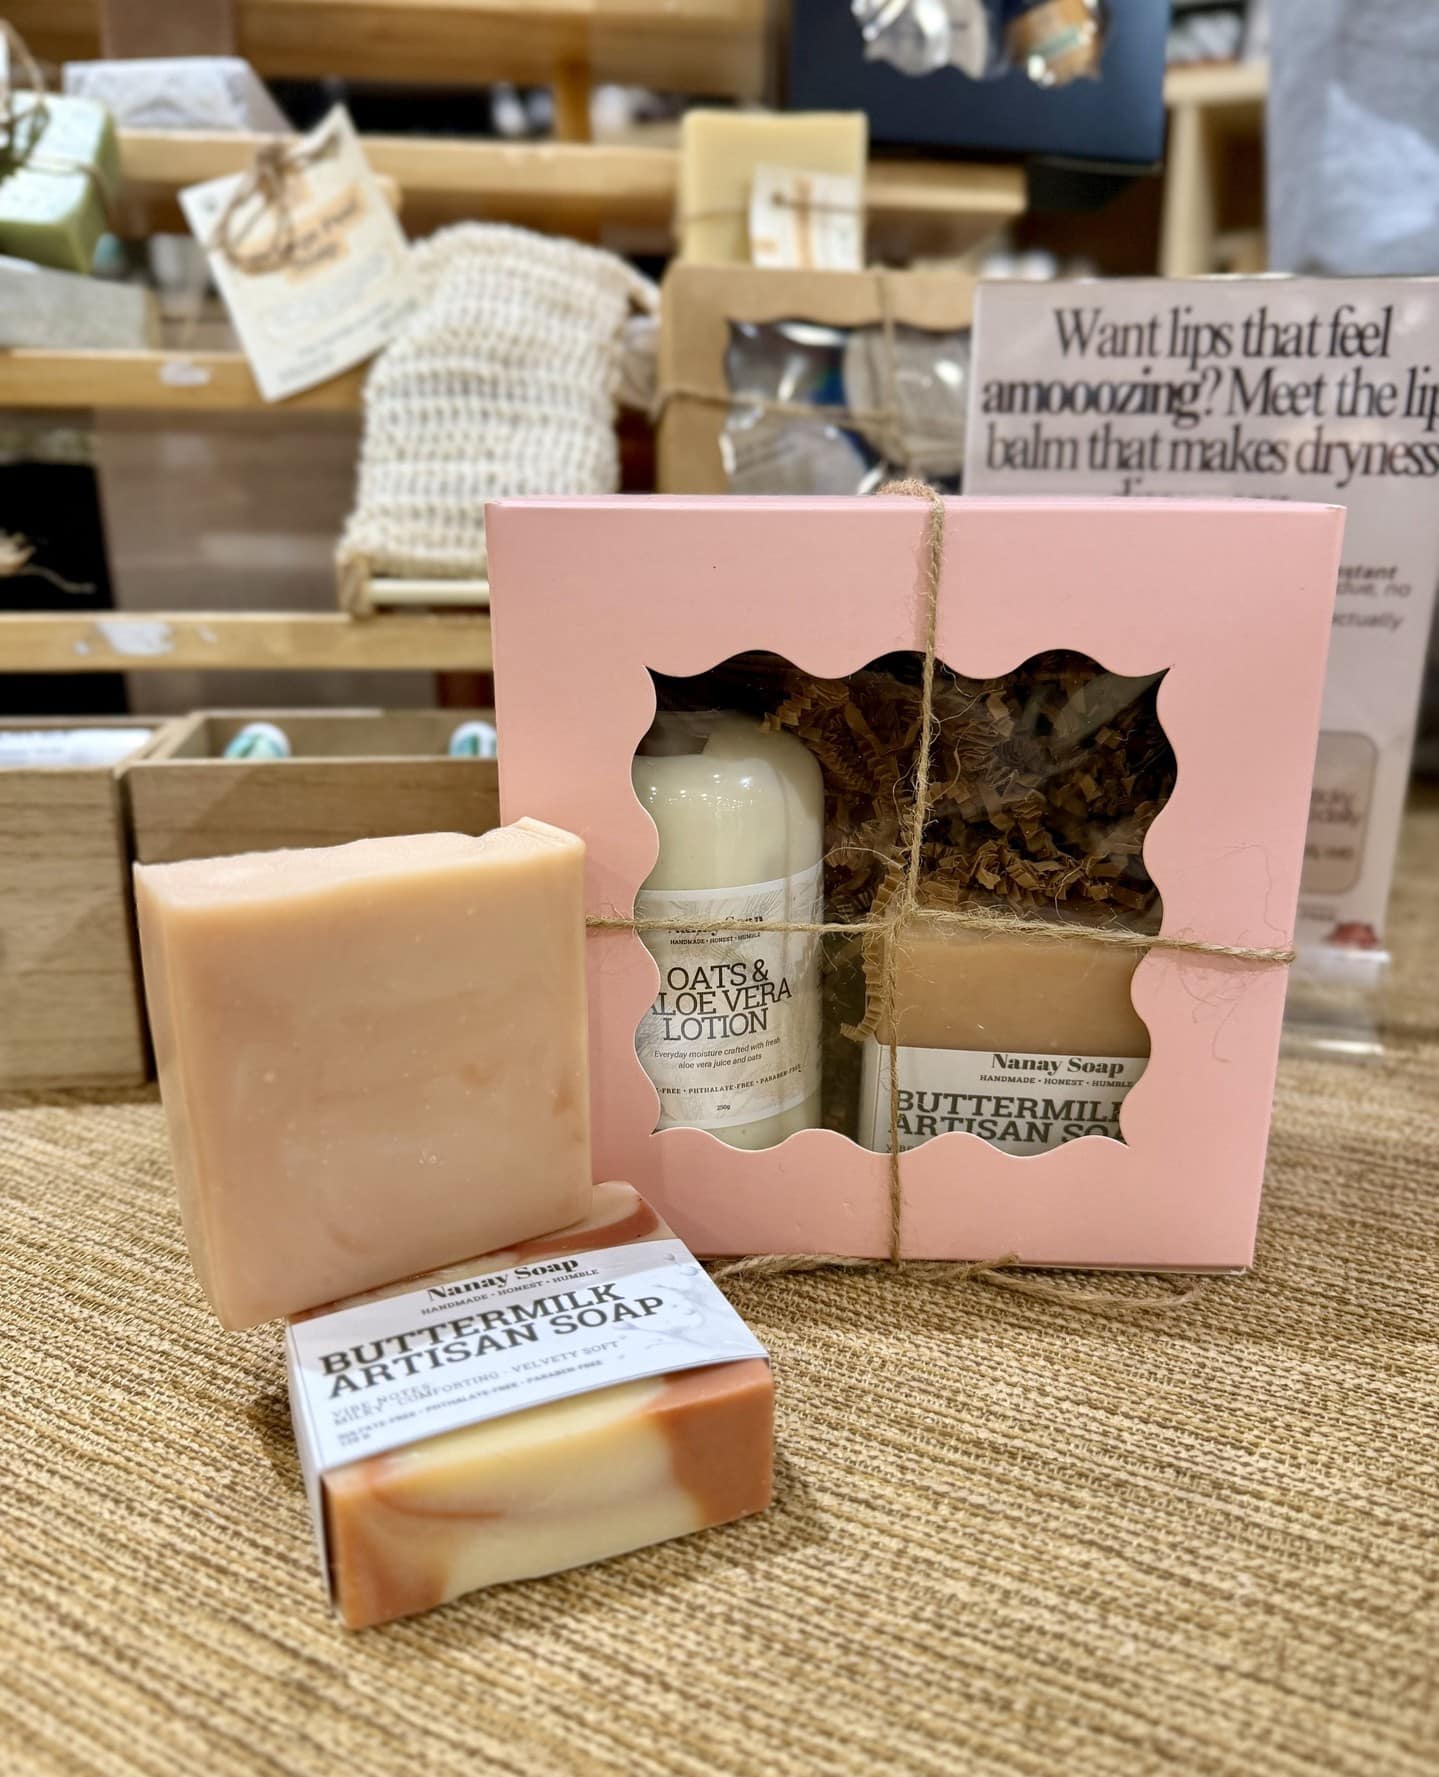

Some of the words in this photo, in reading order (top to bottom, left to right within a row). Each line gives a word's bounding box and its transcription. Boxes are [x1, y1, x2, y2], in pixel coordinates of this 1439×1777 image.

[1054, 307, 1160, 358] Want
[1168, 306, 1234, 372] lips
[1241, 305, 1323, 358] that
[1327, 304, 1393, 358] feel
[982, 365, 1222, 429] amooozing?
[1226, 366, 1327, 417] Meet
[1335, 365, 1398, 417] the
[986, 421, 1079, 471] balm
[1088, 421, 1161, 472] that
[1168, 424, 1289, 474] makes
[1294, 423, 1439, 489] dryness
[709, 935, 734, 944] HONEST
[667, 962, 748, 991] OATS
[752, 959, 769, 983] &
[722, 977, 793, 1013] VERA
[663, 1008, 769, 1041] LOTION
[654, 1050, 687, 1060] Everyday
[688, 1050, 723, 1058] moisture
[723, 1044, 750, 1056] crafted
[750, 1041, 764, 1051] with
[765, 1037, 782, 1048] fresh
[678, 1060, 695, 1069] aloe
[696, 1060, 712, 1069] vera
[712, 1058, 731, 1069] juice
[732, 1055, 746, 1065] and
[747, 1052, 762, 1062] oats
[979, 1074, 1036, 1084] HANDMADE
[1044, 1078, 1085, 1086] HONEST
[1091, 1080, 1134, 1088] HUMBLE
[992, 1053, 1063, 1076] Nanay
[1067, 1057, 1125, 1078] Soap
[688, 1080, 754, 1094] PHTHALATE-FREE
[888, 1112, 1053, 1144] ARTISAN
[421, 1293, 489, 1316] HANDMADE
[499, 1280, 544, 1296] HONEST
[552, 1268, 600, 1283] HUMBLE
[427, 1273, 509, 1302] Nanay
[514, 1258, 579, 1280] Soap
[319, 1282, 625, 1376] BUTTERMILK
[328, 1322, 539, 1400] ARTISAN
[550, 1296, 664, 1335] SOAP
[511, 1350, 578, 1373] VELVETY
[581, 1340, 620, 1355] SOFT
